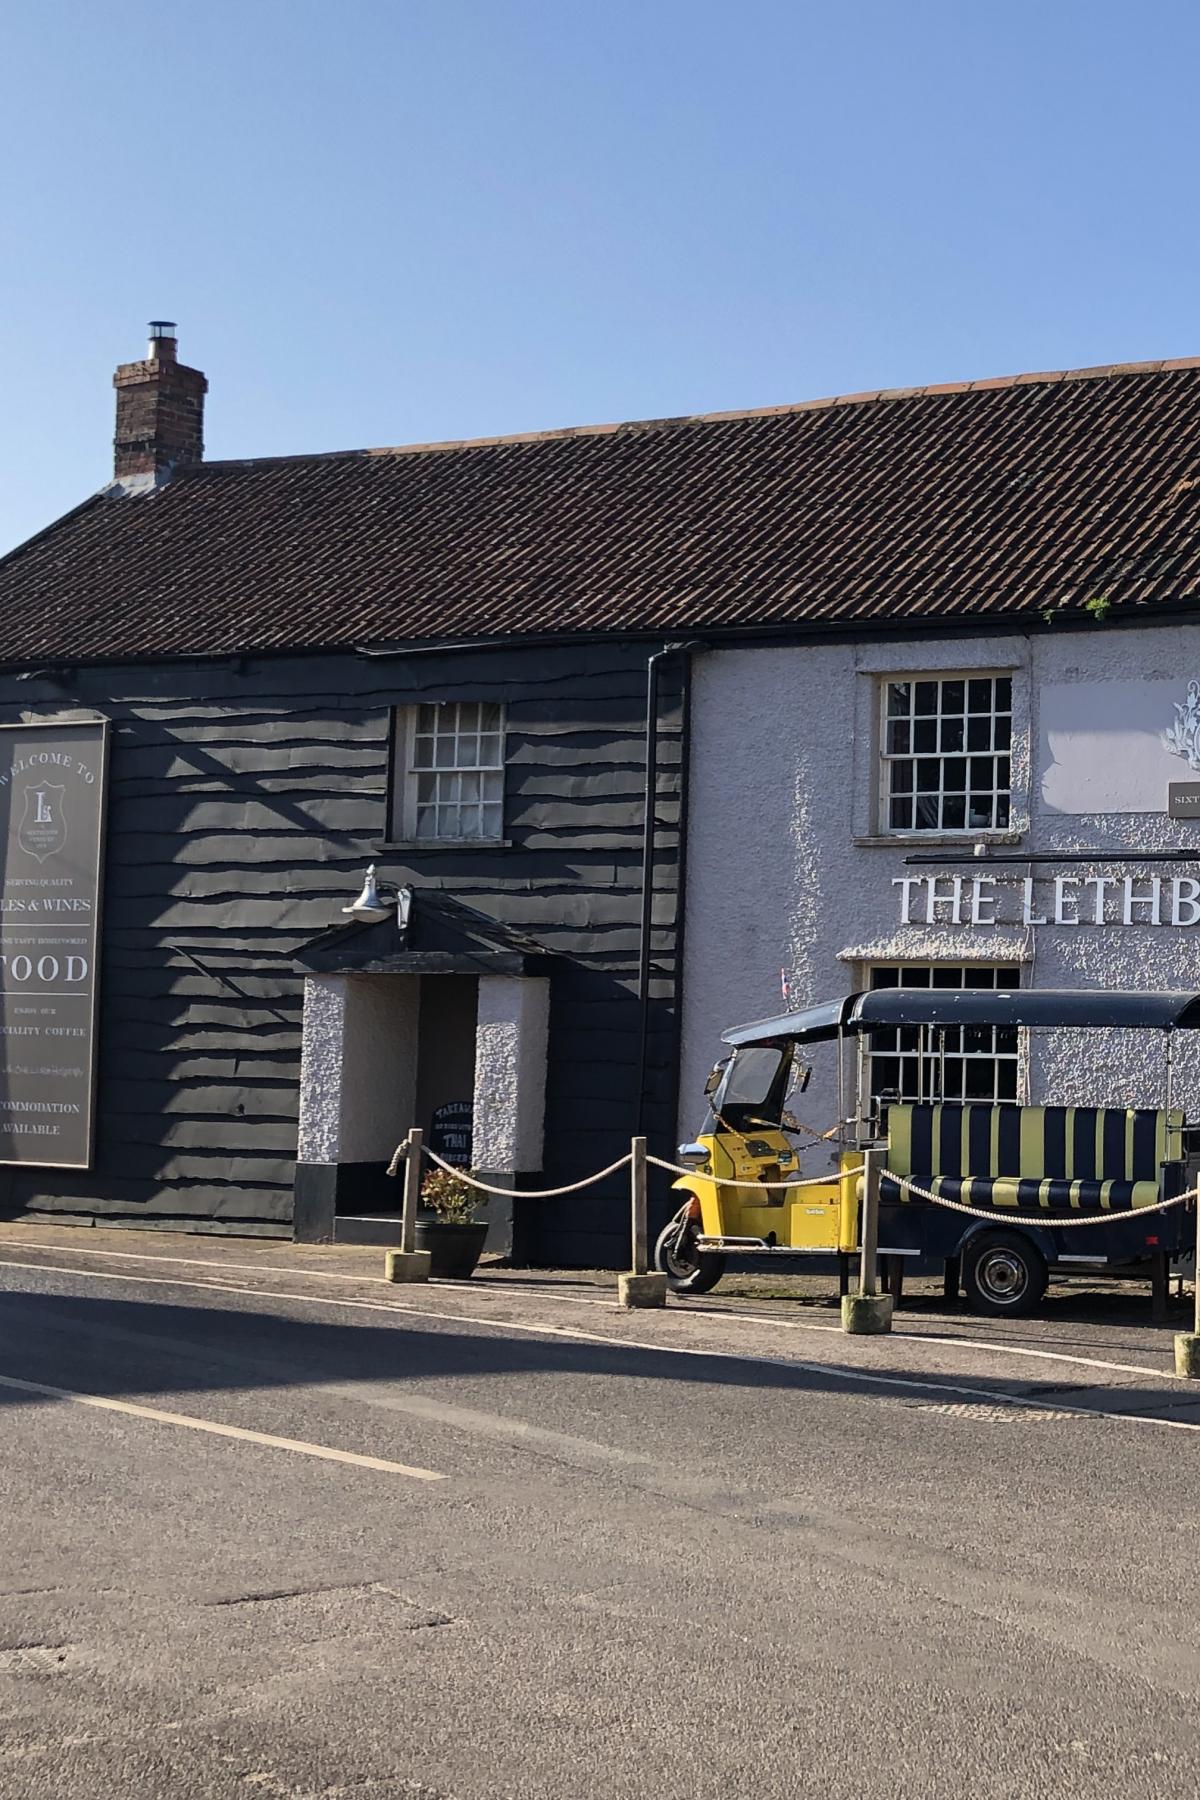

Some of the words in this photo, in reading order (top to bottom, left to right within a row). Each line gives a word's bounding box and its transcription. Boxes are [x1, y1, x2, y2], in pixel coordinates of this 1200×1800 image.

[77, 762, 95, 784] TO
[0, 899, 26, 912] LES
[28, 899, 39, 912] &
[43, 898, 92, 912] WINES
[891, 877, 997, 926] THE
[1, 1122, 60, 1135] AVAILABLE
